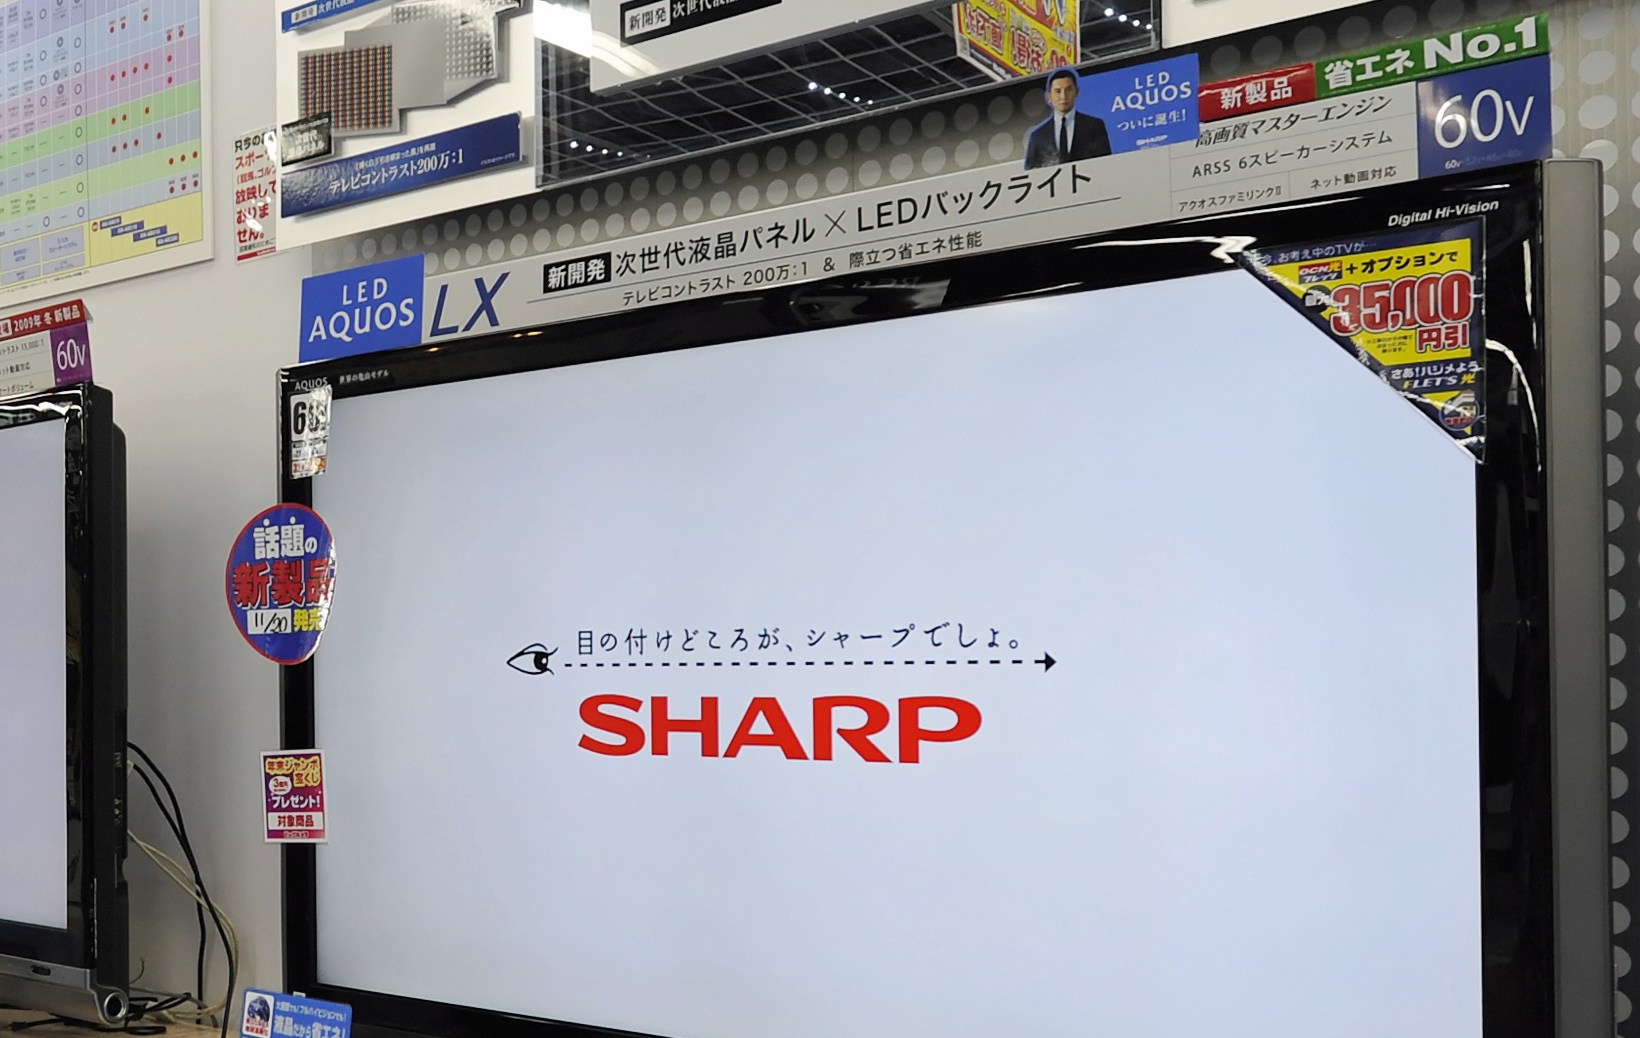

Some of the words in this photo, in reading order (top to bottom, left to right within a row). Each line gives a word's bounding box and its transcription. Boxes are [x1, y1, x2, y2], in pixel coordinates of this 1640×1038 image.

[629, 7, 667, 31] 新開発
[1324, 50, 1415, 91] 省エネ
[1424, 17, 1539, 70] No.1
[1110, 80, 1192, 113] AQUOS
[1134, 70, 1170, 91] LED
[1220, 77, 1293, 111] 新製品
[1116, 108, 1187, 131] ついに誕生!
[1195, 95, 1393, 149] 高画質マスターエンジン
[1135, 133, 1169, 146] SHARP
[1192, 158, 1232, 178] ARSS
[1239, 130, 1393, 170] 6スピーカーシステム
[328, 148, 464, 196] テレビコントラスト200万:1
[1309, 164, 1398, 191] ネット動画対応
[547, 256, 607, 289] 新開発
[615, 216, 816, 277] 次世代液晶パネル
[857, 163, 1092, 234] LEDバックライト
[1388, 209, 1432, 228] Digital
[1435, 199, 1499, 220] Hi-Vision
[622, 273, 737, 307] テレビコントラスト
[848, 230, 983, 270] 際立つ省エネ性能
[343, 278, 388, 307] LED
[429, 271, 511, 338] LX
[1331, 271, 1474, 336] 35,000
[14, 316, 42, 332] 2009年
[54, 304, 80, 322] 新製品
[308, 298, 415, 343] AQUOS
[1416, 322, 1470, 353] 円引
[294, 376, 328, 391] AQUOS
[1403, 374, 1458, 389] FLET'S
[253, 522, 318, 560] 話題の
[232, 558, 332, 609] 新製品
[577, 622, 1020, 656] 目の付けどころが、シャープでしょ。
[577, 694, 982, 764] SHARP
[271, 794, 321, 809] プレゼント!
[277, 814, 314, 828] 対象商品
